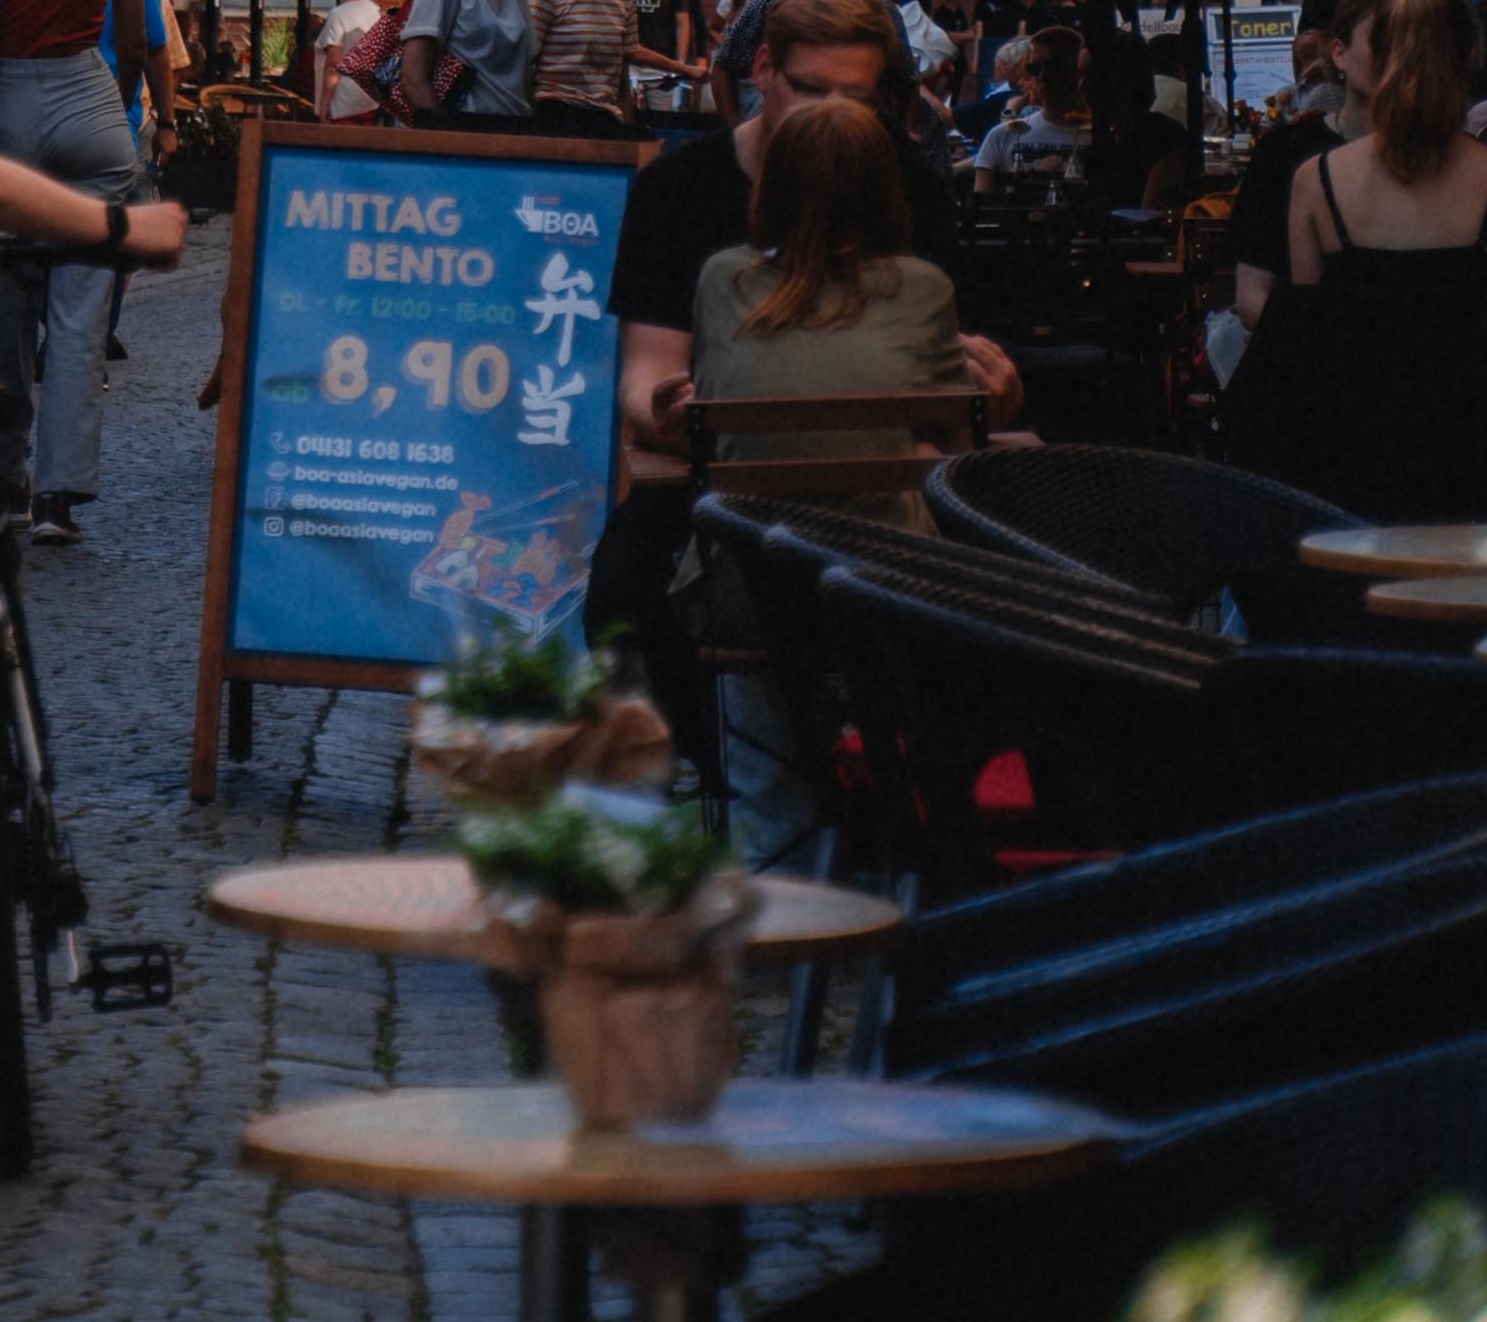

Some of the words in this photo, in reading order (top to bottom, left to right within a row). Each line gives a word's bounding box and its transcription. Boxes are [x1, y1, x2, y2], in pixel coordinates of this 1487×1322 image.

[284, 189, 463, 237] MITTAG
[544, 210, 600, 237] BOA
[345, 241, 495, 288] BENTO
[323, 333, 511, 419] 8,90
[295, 435, 353, 458] 04131
[358, 440, 401, 461] 608
[406, 442, 455, 465] 1638
[293, 465, 459, 491] boa-asiavegan.de
[290, 493, 437, 518] @boaasiavegan
[289, 520, 435, 545] @boaasiavegan
